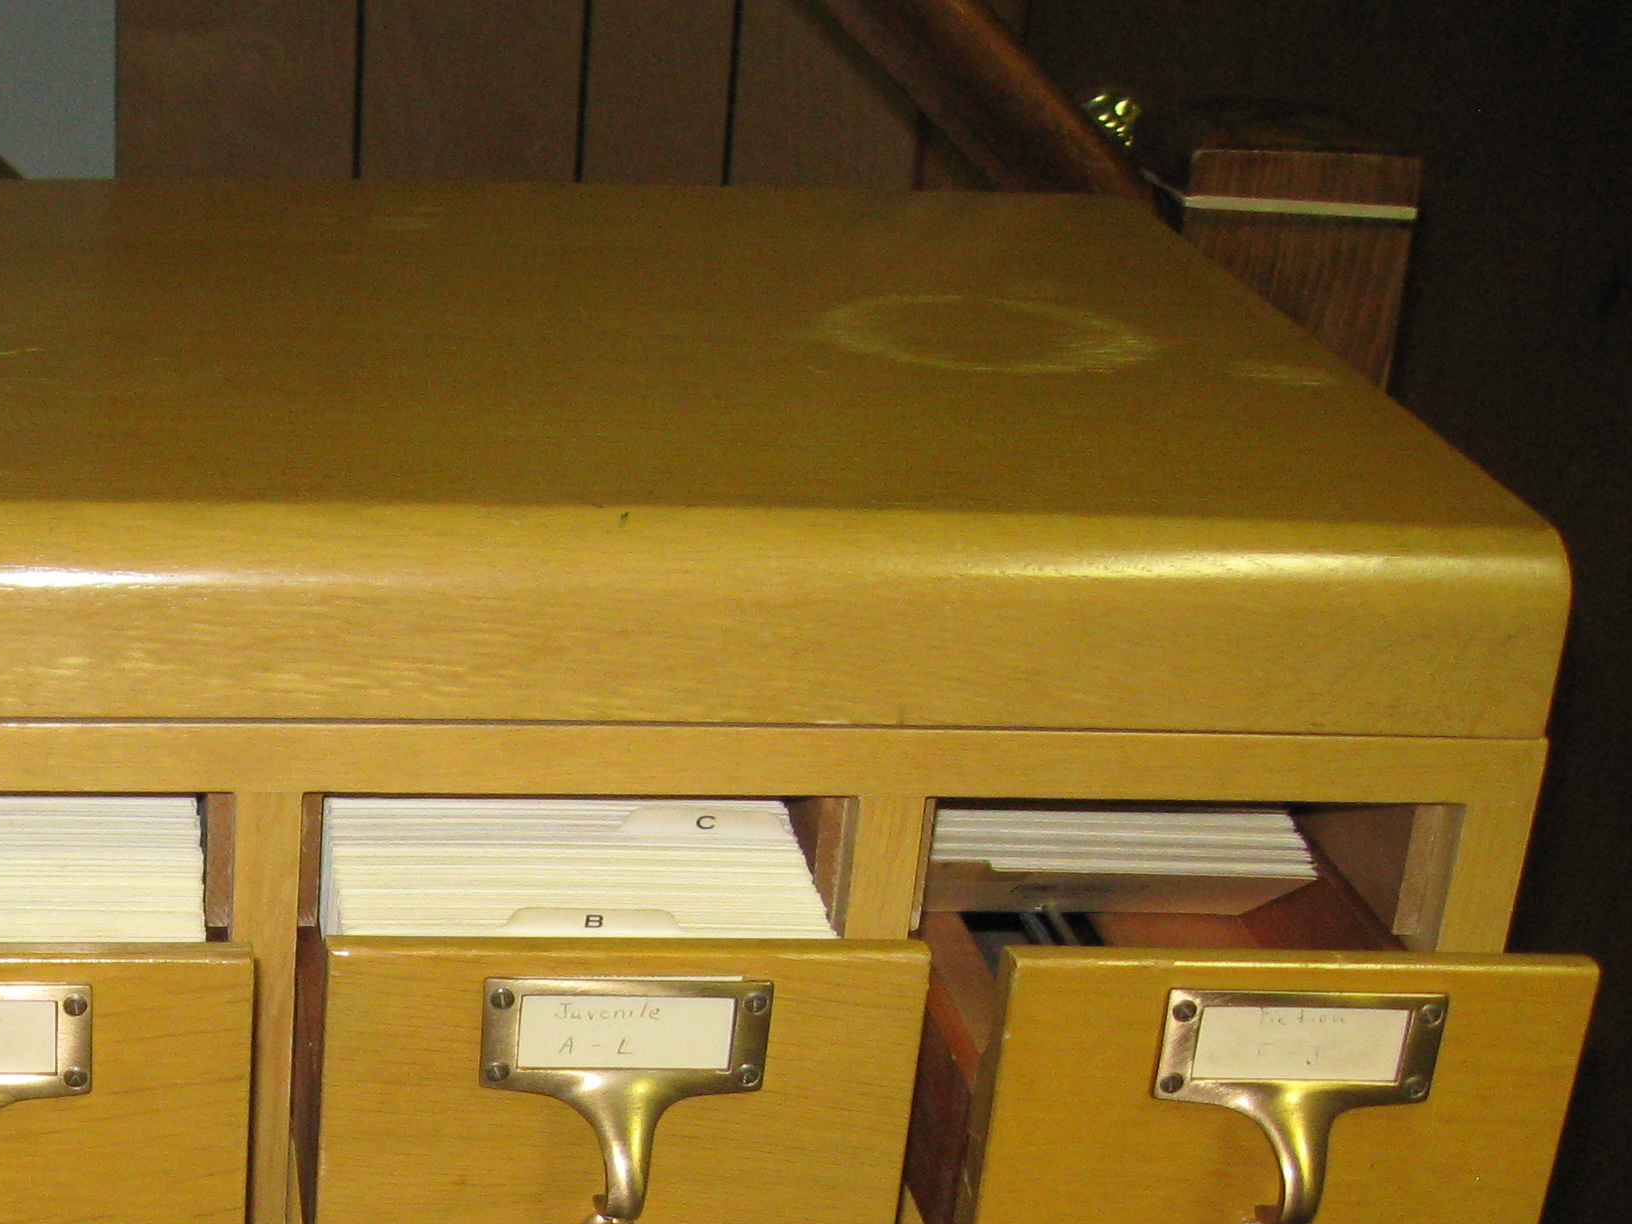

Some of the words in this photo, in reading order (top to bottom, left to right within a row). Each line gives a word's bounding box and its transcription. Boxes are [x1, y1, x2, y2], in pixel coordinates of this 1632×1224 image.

[696, 815, 716, 829] C
[584, 914, 604, 928] B
[554, 1000, 663, 1021] Juvenile
[558, 1036, 574, 1054] A
[617, 1036, 633, 1055] L
